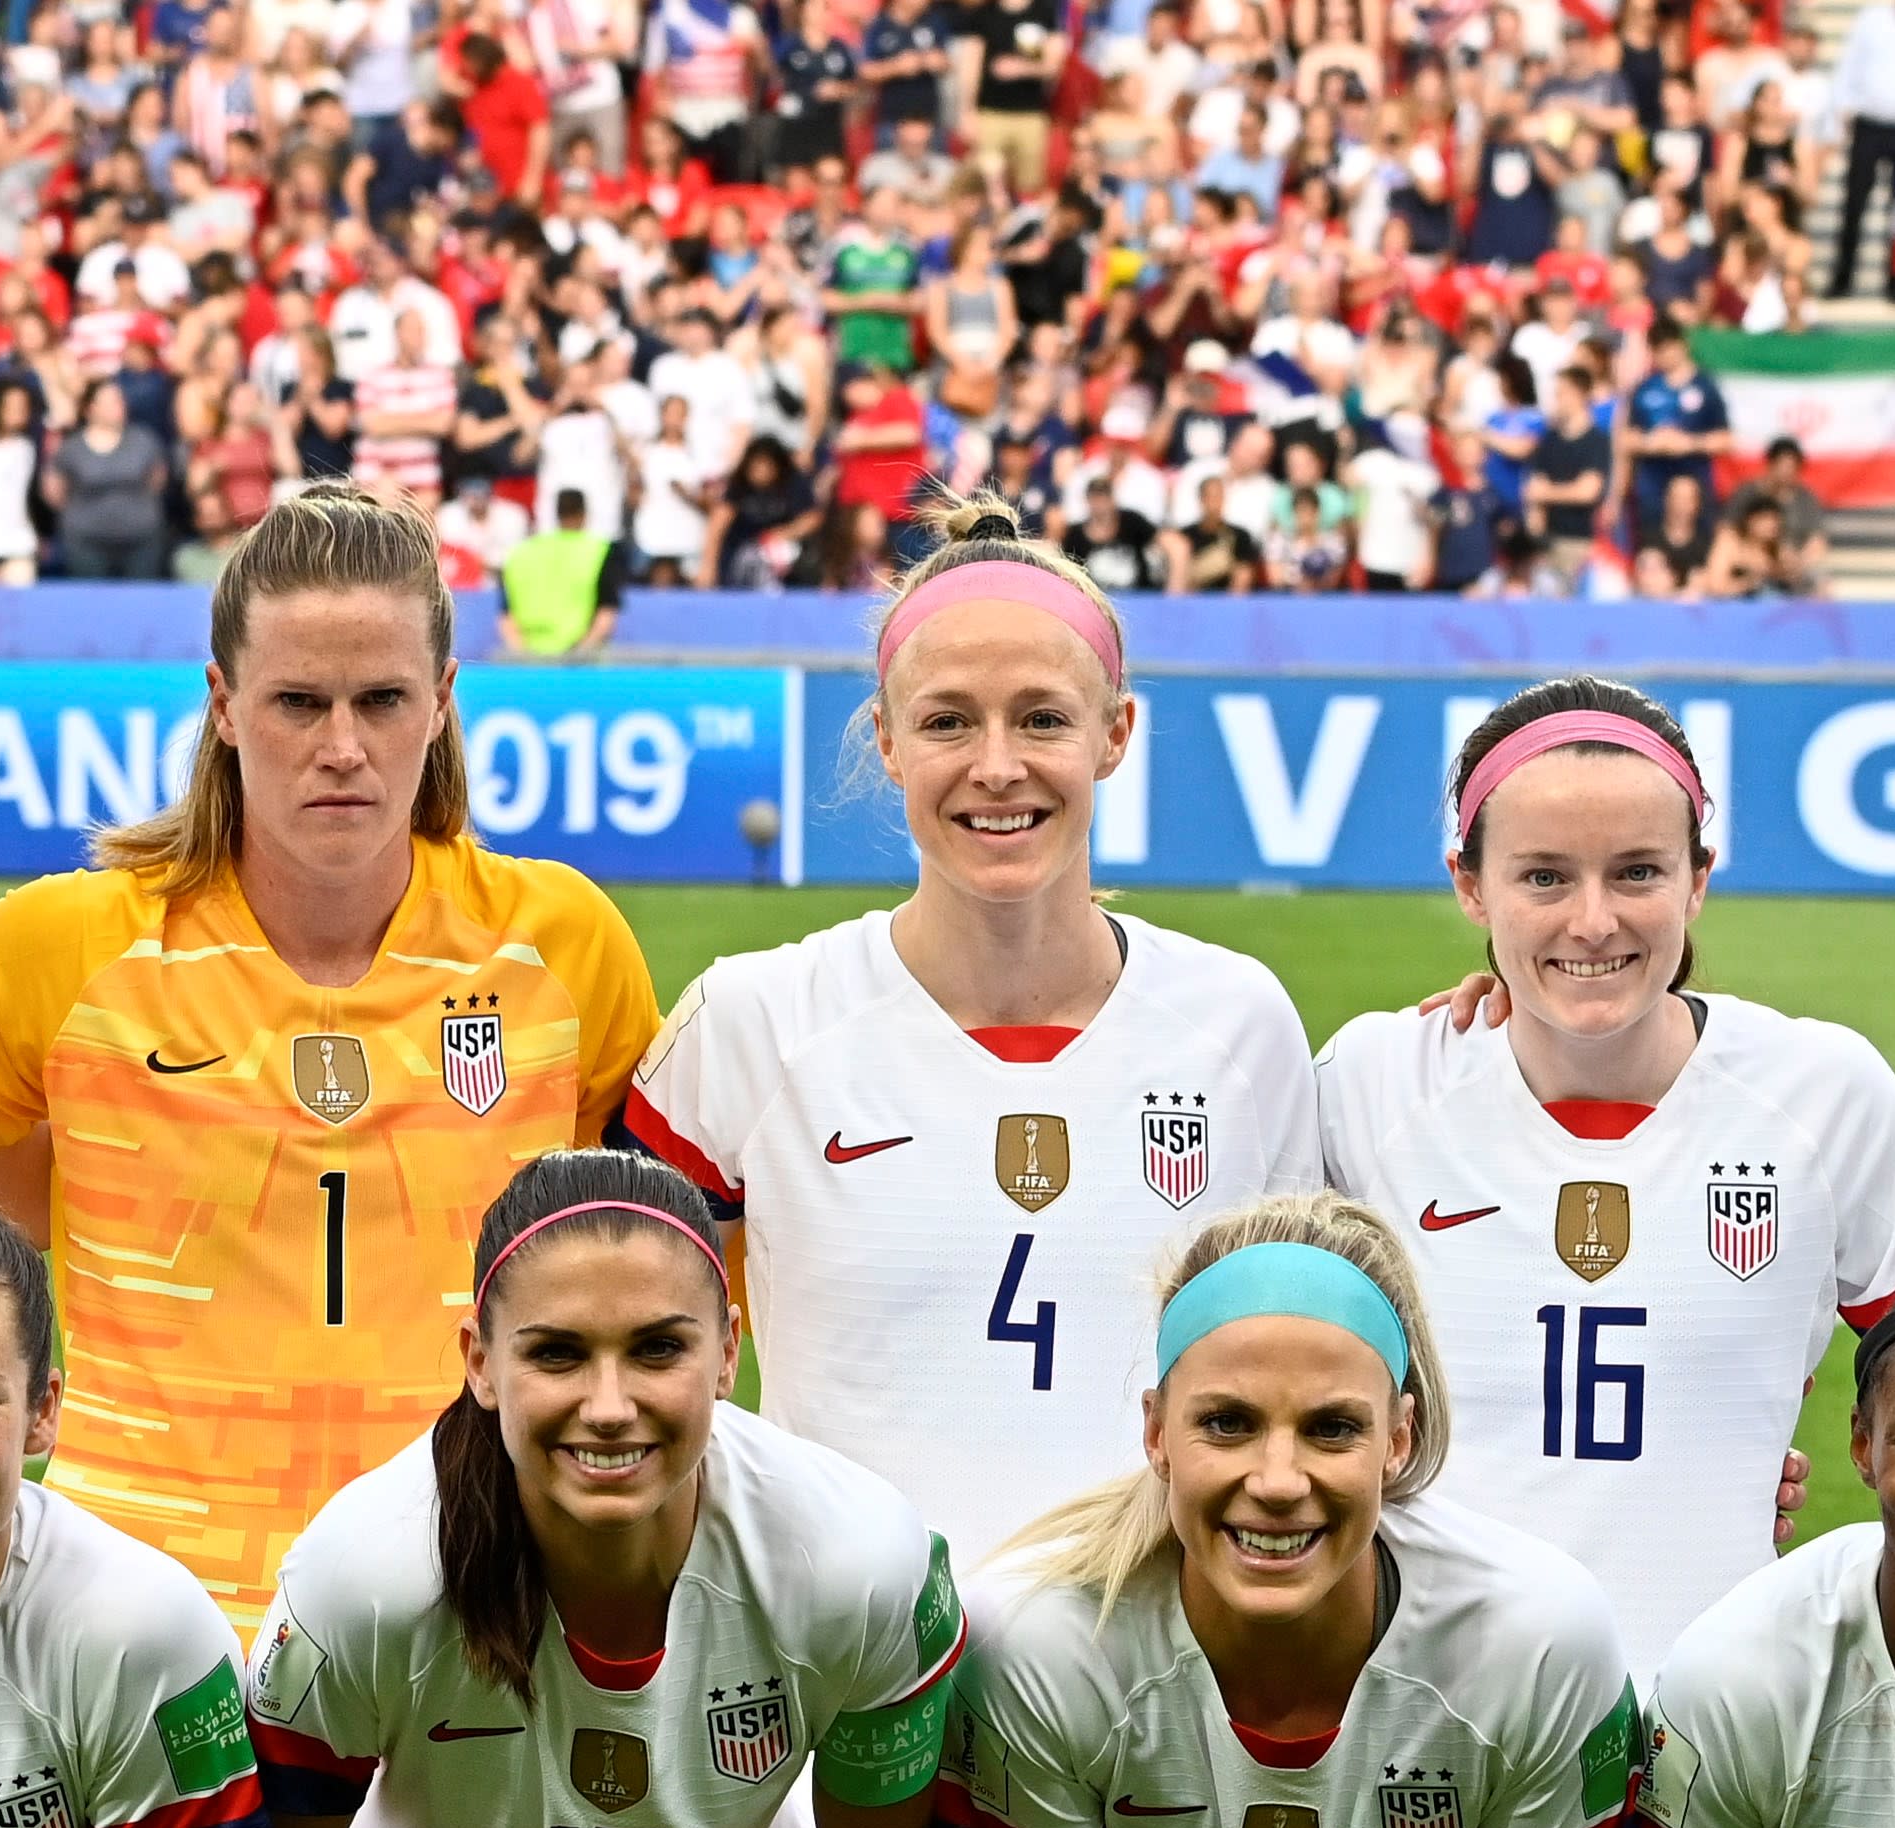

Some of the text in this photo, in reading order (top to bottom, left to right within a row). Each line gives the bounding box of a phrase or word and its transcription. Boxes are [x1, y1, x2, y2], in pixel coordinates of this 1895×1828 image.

[448, 1021, 496, 1058] USA
[316, 1090, 350, 1102] FIFA
[1149, 1118, 1202, 1154] USA
[1015, 1175, 1049, 1188] FIFA
[1714, 1190, 1771, 1225] USA
[317, 1170, 347, 1327] 1
[1574, 1244, 1609, 1257] FIFA
[987, 1233, 1056, 1390] 4
[1536, 1304, 1647, 1461] 16
[169, 1687, 237, 1739] LIVING
[257, 1694, 281, 1711] 2019
[172, 1700, 241, 1748] FOOTBALL
[717, 1704, 781, 1740] USA
[831, 1720, 935, 1758] OTBALL
[837, 1701, 936, 1741] VING
[880, 1749, 934, 1787] FIFA
[592, 1780, 626, 1795] FIFA
[1388, 1791, 1452, 1820] USA
[1651, 1800, 1672, 1819] 2019
